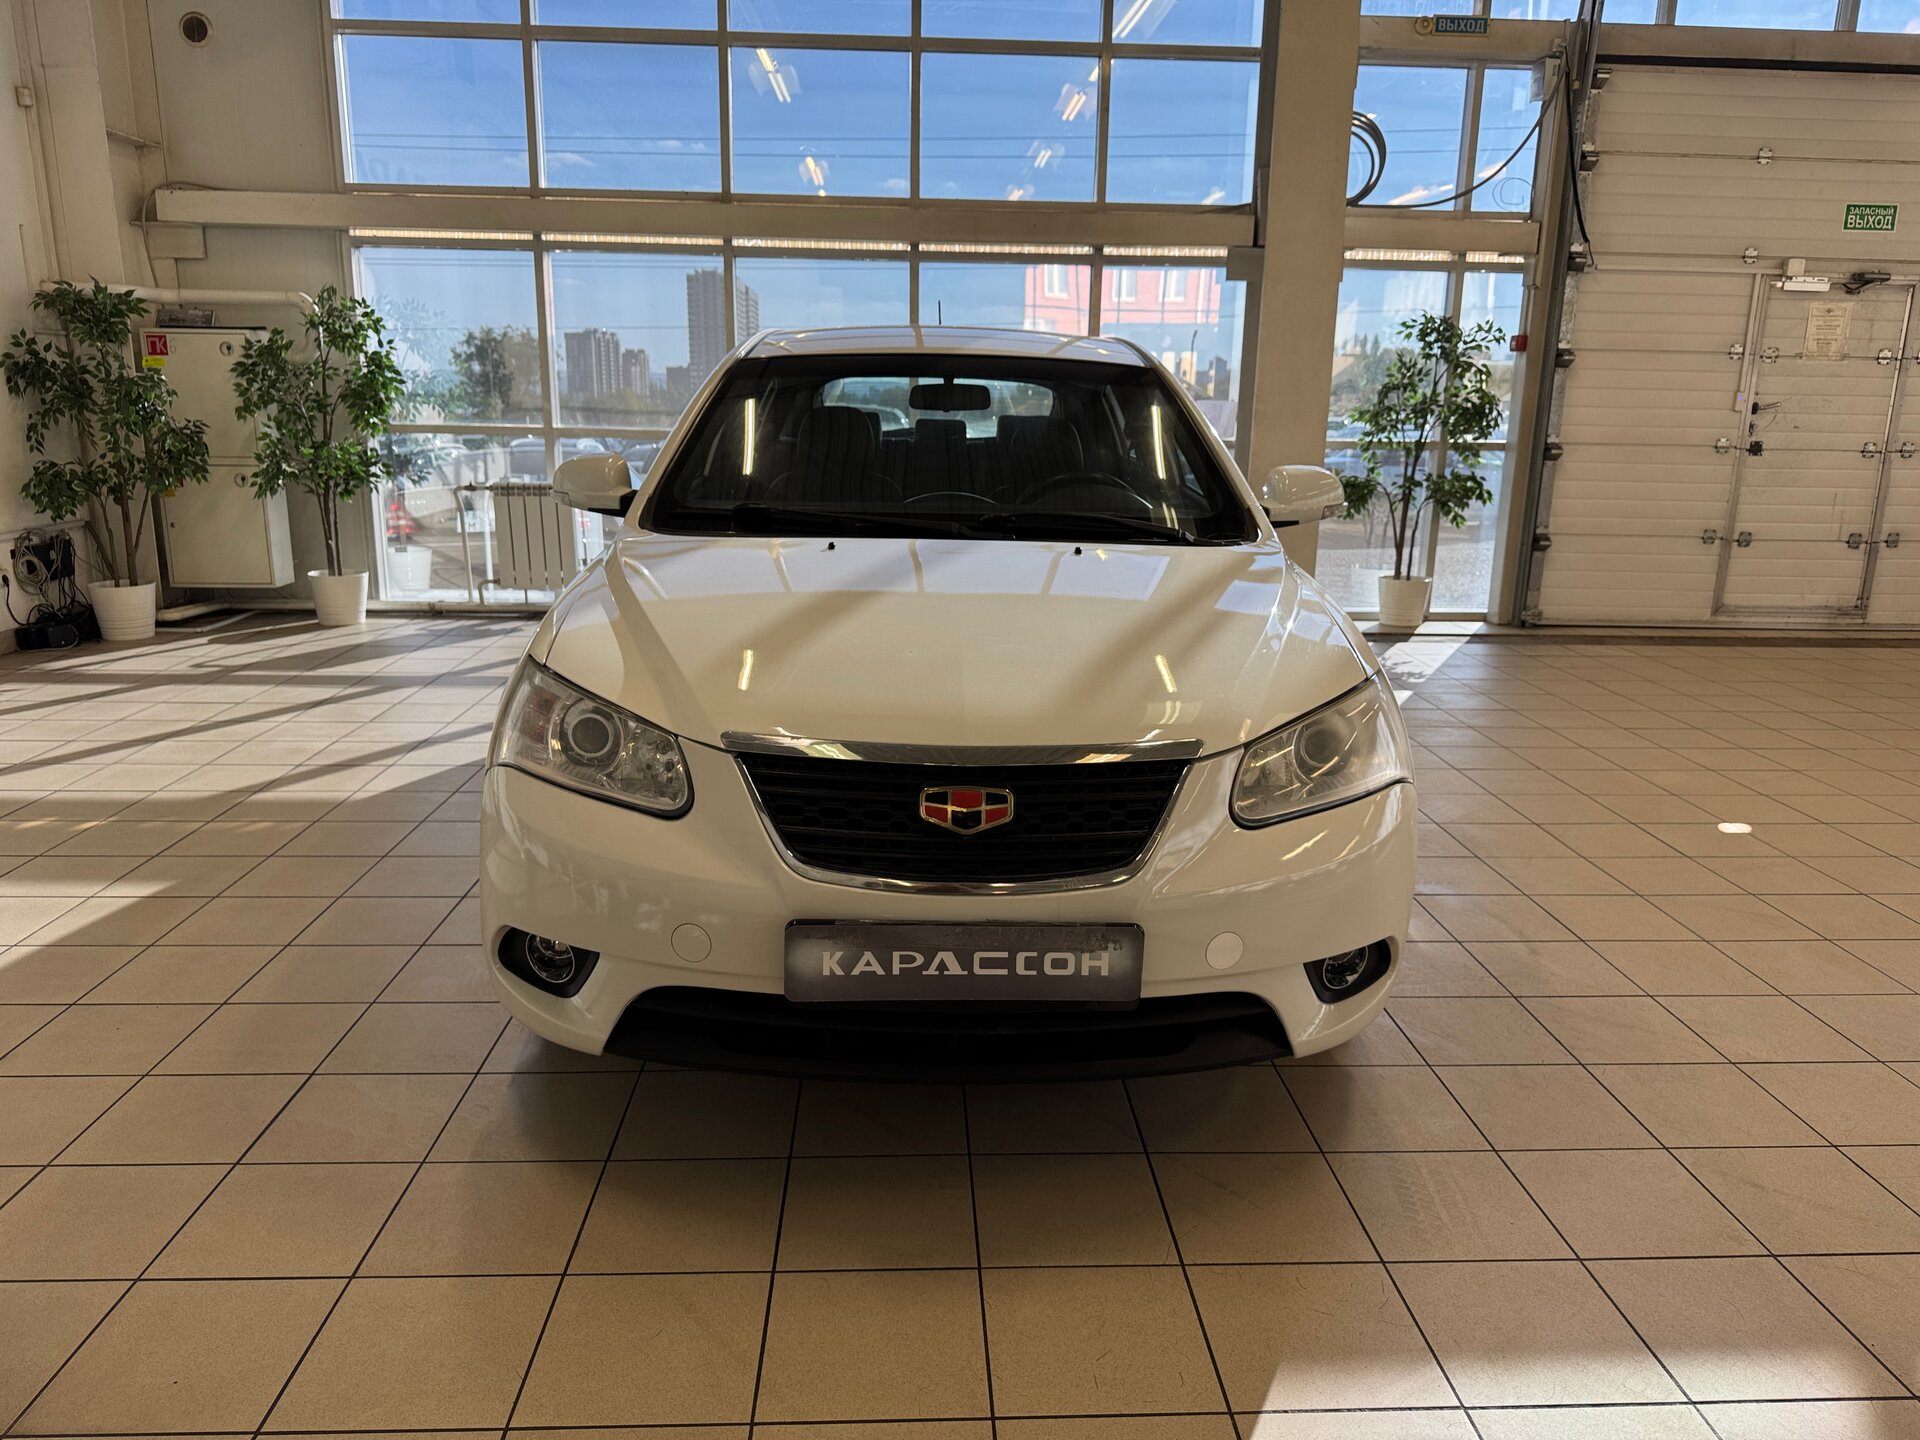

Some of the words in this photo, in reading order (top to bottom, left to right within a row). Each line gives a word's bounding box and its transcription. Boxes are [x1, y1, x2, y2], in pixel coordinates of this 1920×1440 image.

[1438, 19, 1485, 32] ВЫХОД
[1849, 206, 1894, 216] ЗАПАСНЫЙ
[1847, 215, 1892, 229] ВЫХОД
[147, 337, 167, 353] ПК
